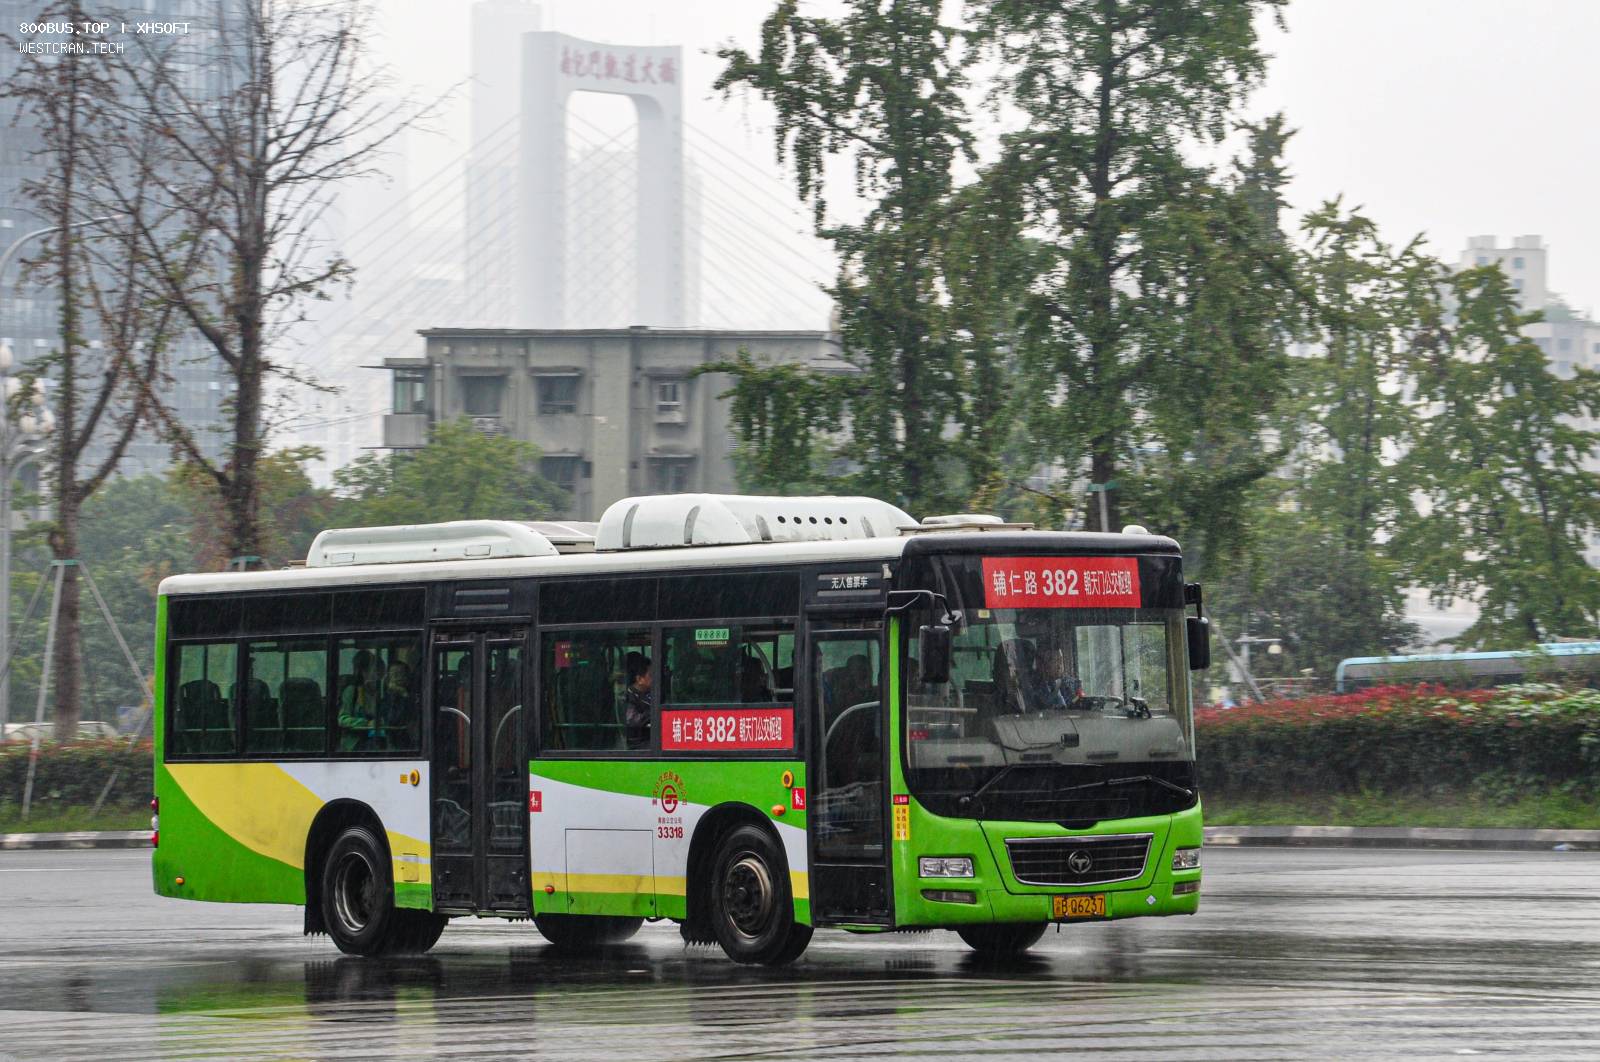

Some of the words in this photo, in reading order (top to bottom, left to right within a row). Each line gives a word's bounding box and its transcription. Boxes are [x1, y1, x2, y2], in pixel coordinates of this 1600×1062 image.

[831, 576, 869, 589] 无人售票车
[992, 570, 1038, 596] 辅仁路
[1041, 569, 1080, 596] 382
[1083, 570, 1133, 595] 朝天门公交枢纽
[672, 717, 704, 743] 辅仁路
[706, 716, 736, 742] 382
[739, 716, 782, 742] 朝天门公交枢纽
[657, 826, 684, 839] 33318
